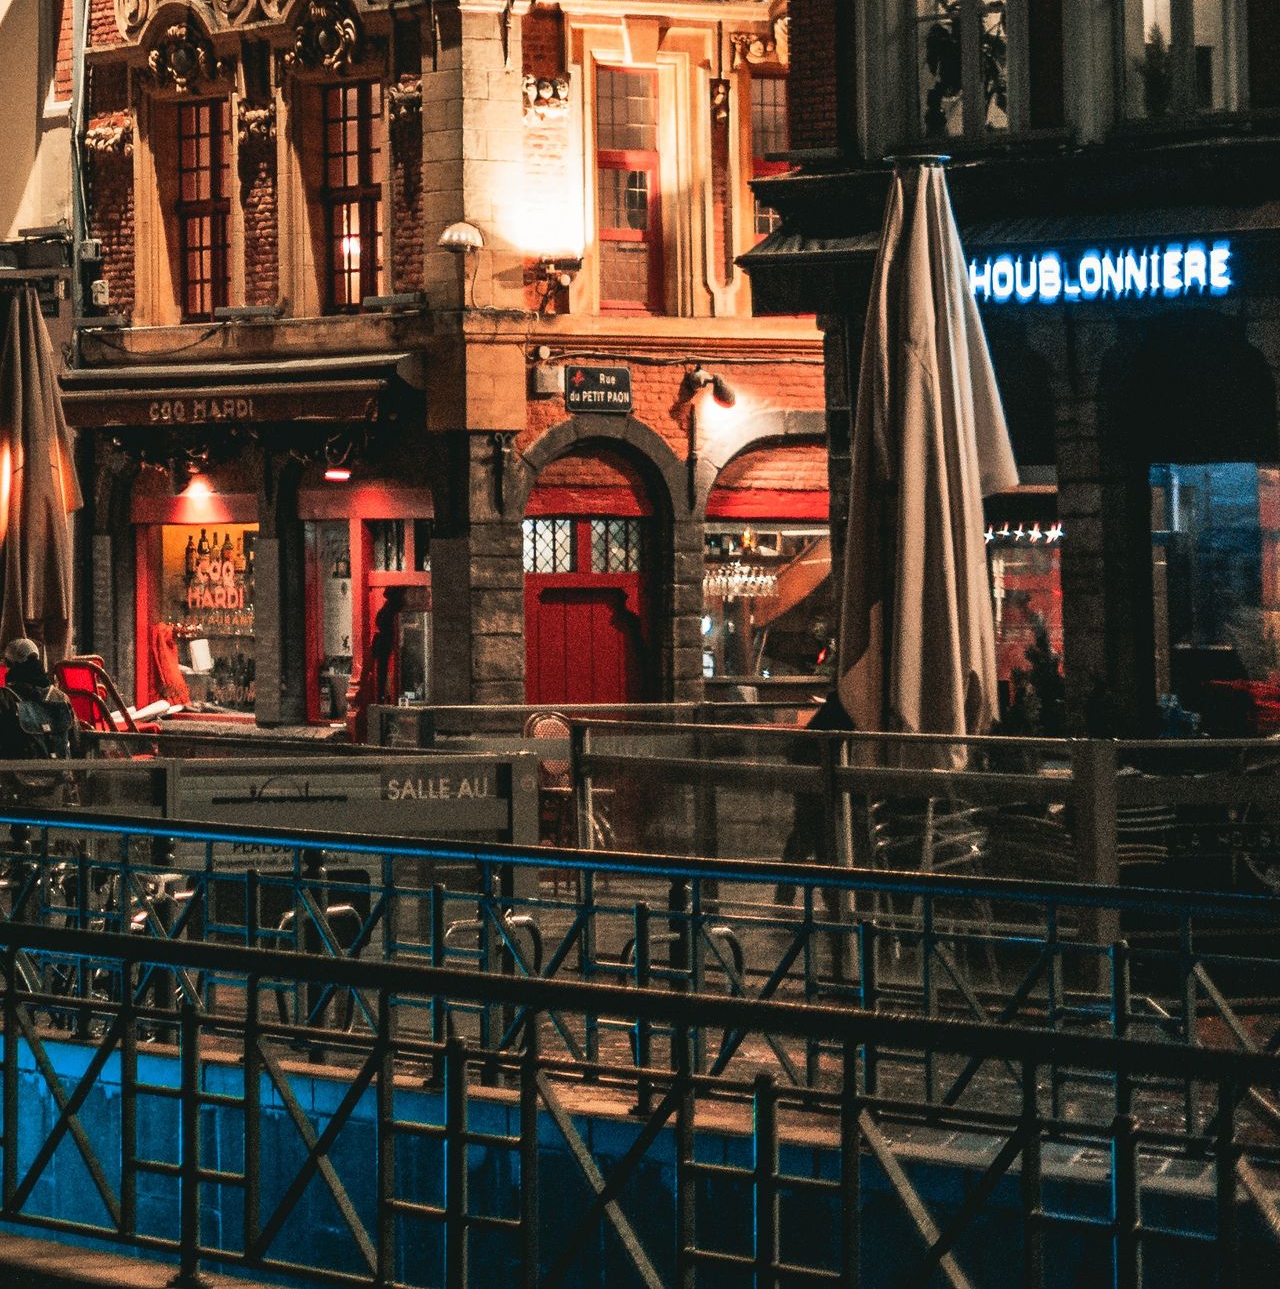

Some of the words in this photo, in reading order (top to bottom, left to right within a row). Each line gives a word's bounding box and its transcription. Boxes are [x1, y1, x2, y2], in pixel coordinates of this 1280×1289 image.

[600, 373, 616, 385] Rue
[570, 391, 580, 402] du
[582, 391, 605, 402] PETIT
[607, 391, 630, 403] PAON
[149, 401, 185, 422] COQ
[193, 399, 253, 423] HARDI
[198, 561, 235, 588] COQ
[188, 585, 244, 609] HARDI
[388, 777, 451, 800] SALLE
[457, 775, 487, 798] AU
